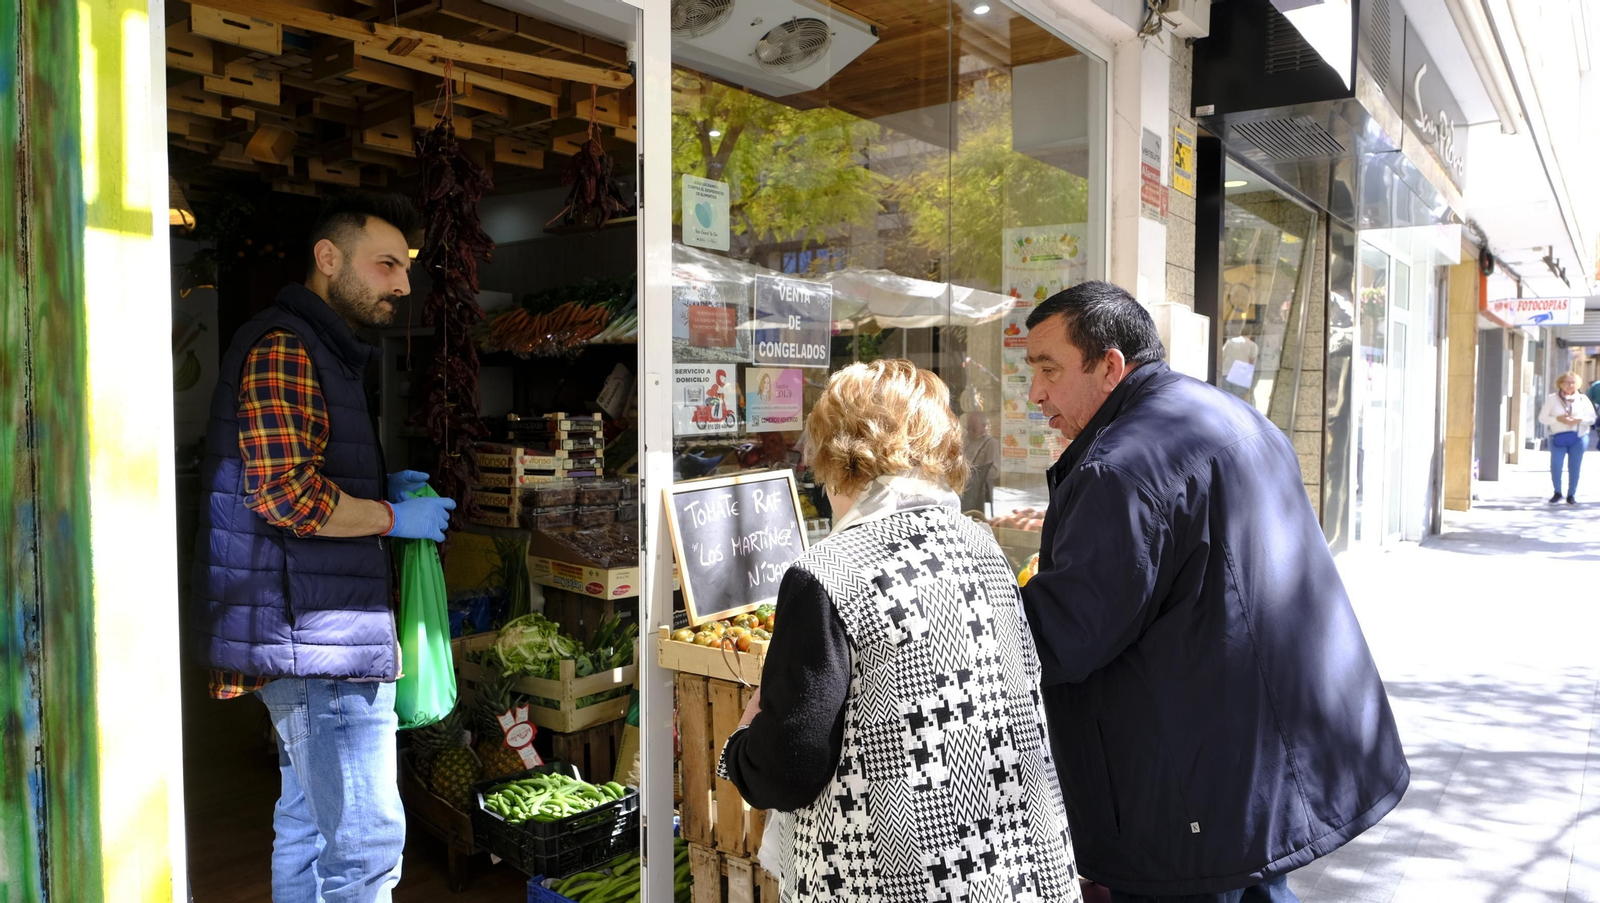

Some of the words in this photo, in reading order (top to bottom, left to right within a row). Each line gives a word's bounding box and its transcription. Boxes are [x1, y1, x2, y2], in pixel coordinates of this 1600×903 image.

[780, 286, 811, 304] VENTA
[1516, 299, 1568, 312] FOTOCOPIAS
[788, 314, 801, 331] DE
[759, 341, 826, 360] CONGELADOS
[751, 488, 782, 514] RAF
